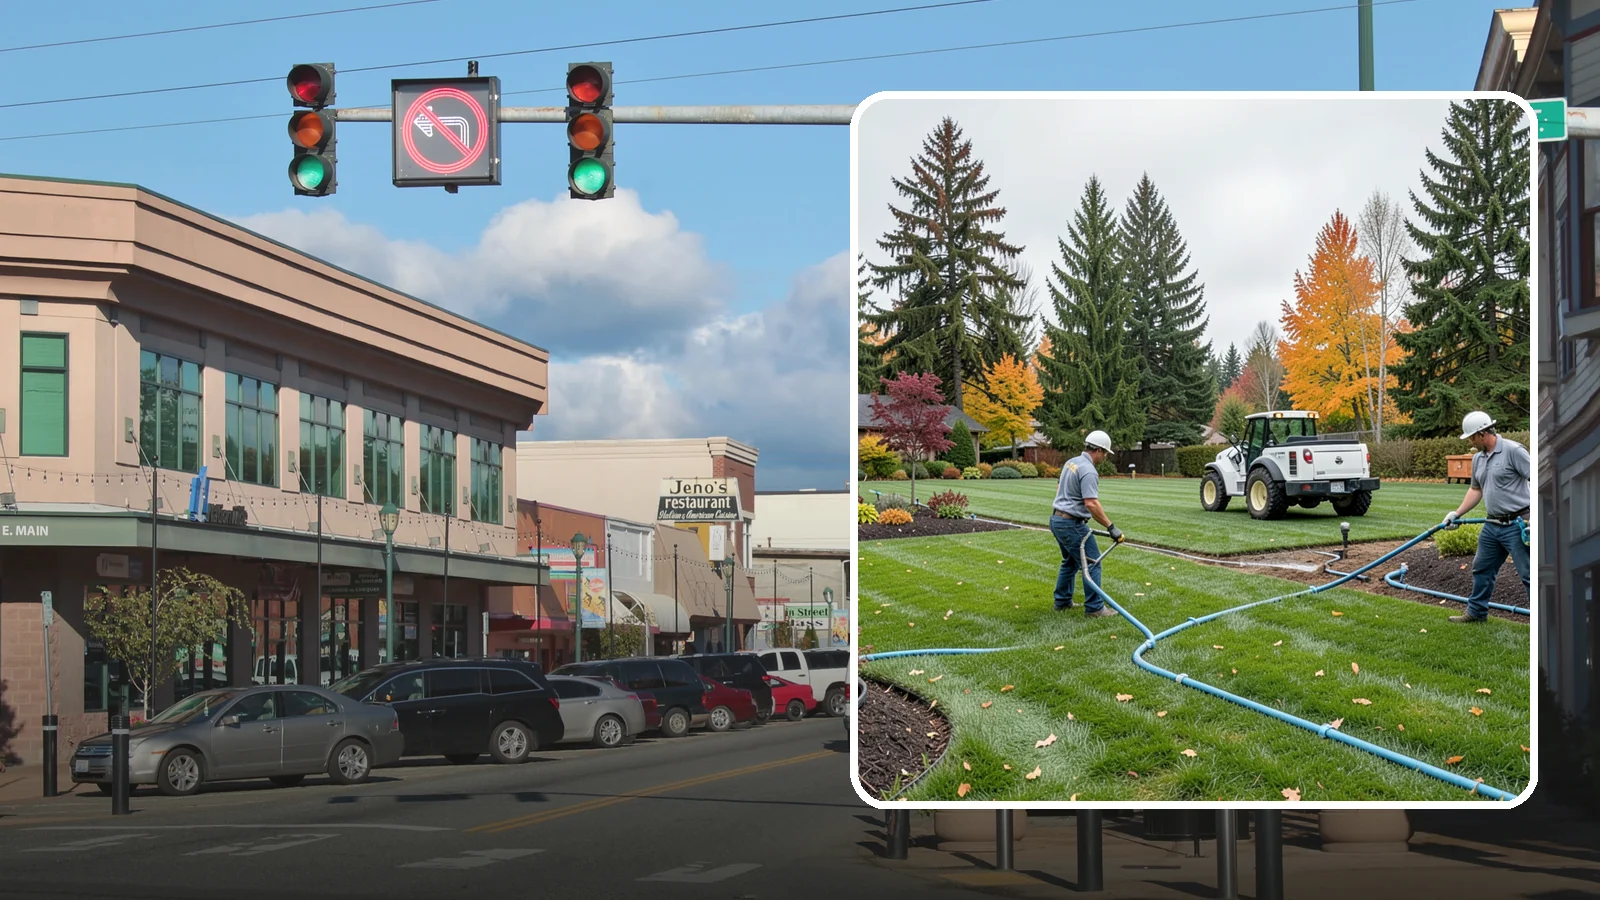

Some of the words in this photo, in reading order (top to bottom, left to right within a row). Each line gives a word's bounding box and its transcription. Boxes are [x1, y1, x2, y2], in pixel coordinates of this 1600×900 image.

[670, 480, 727, 494] Jeno's
[665, 496, 731, 509] restaurant
[659, 510, 681, 519] Italian
[686, 509, 714, 519] American
[715, 509, 737, 519] Cuisine
[2, 525, 13, 536] E.
[15, 525, 49, 536] MAIN
[797, 607, 828, 617] Street
